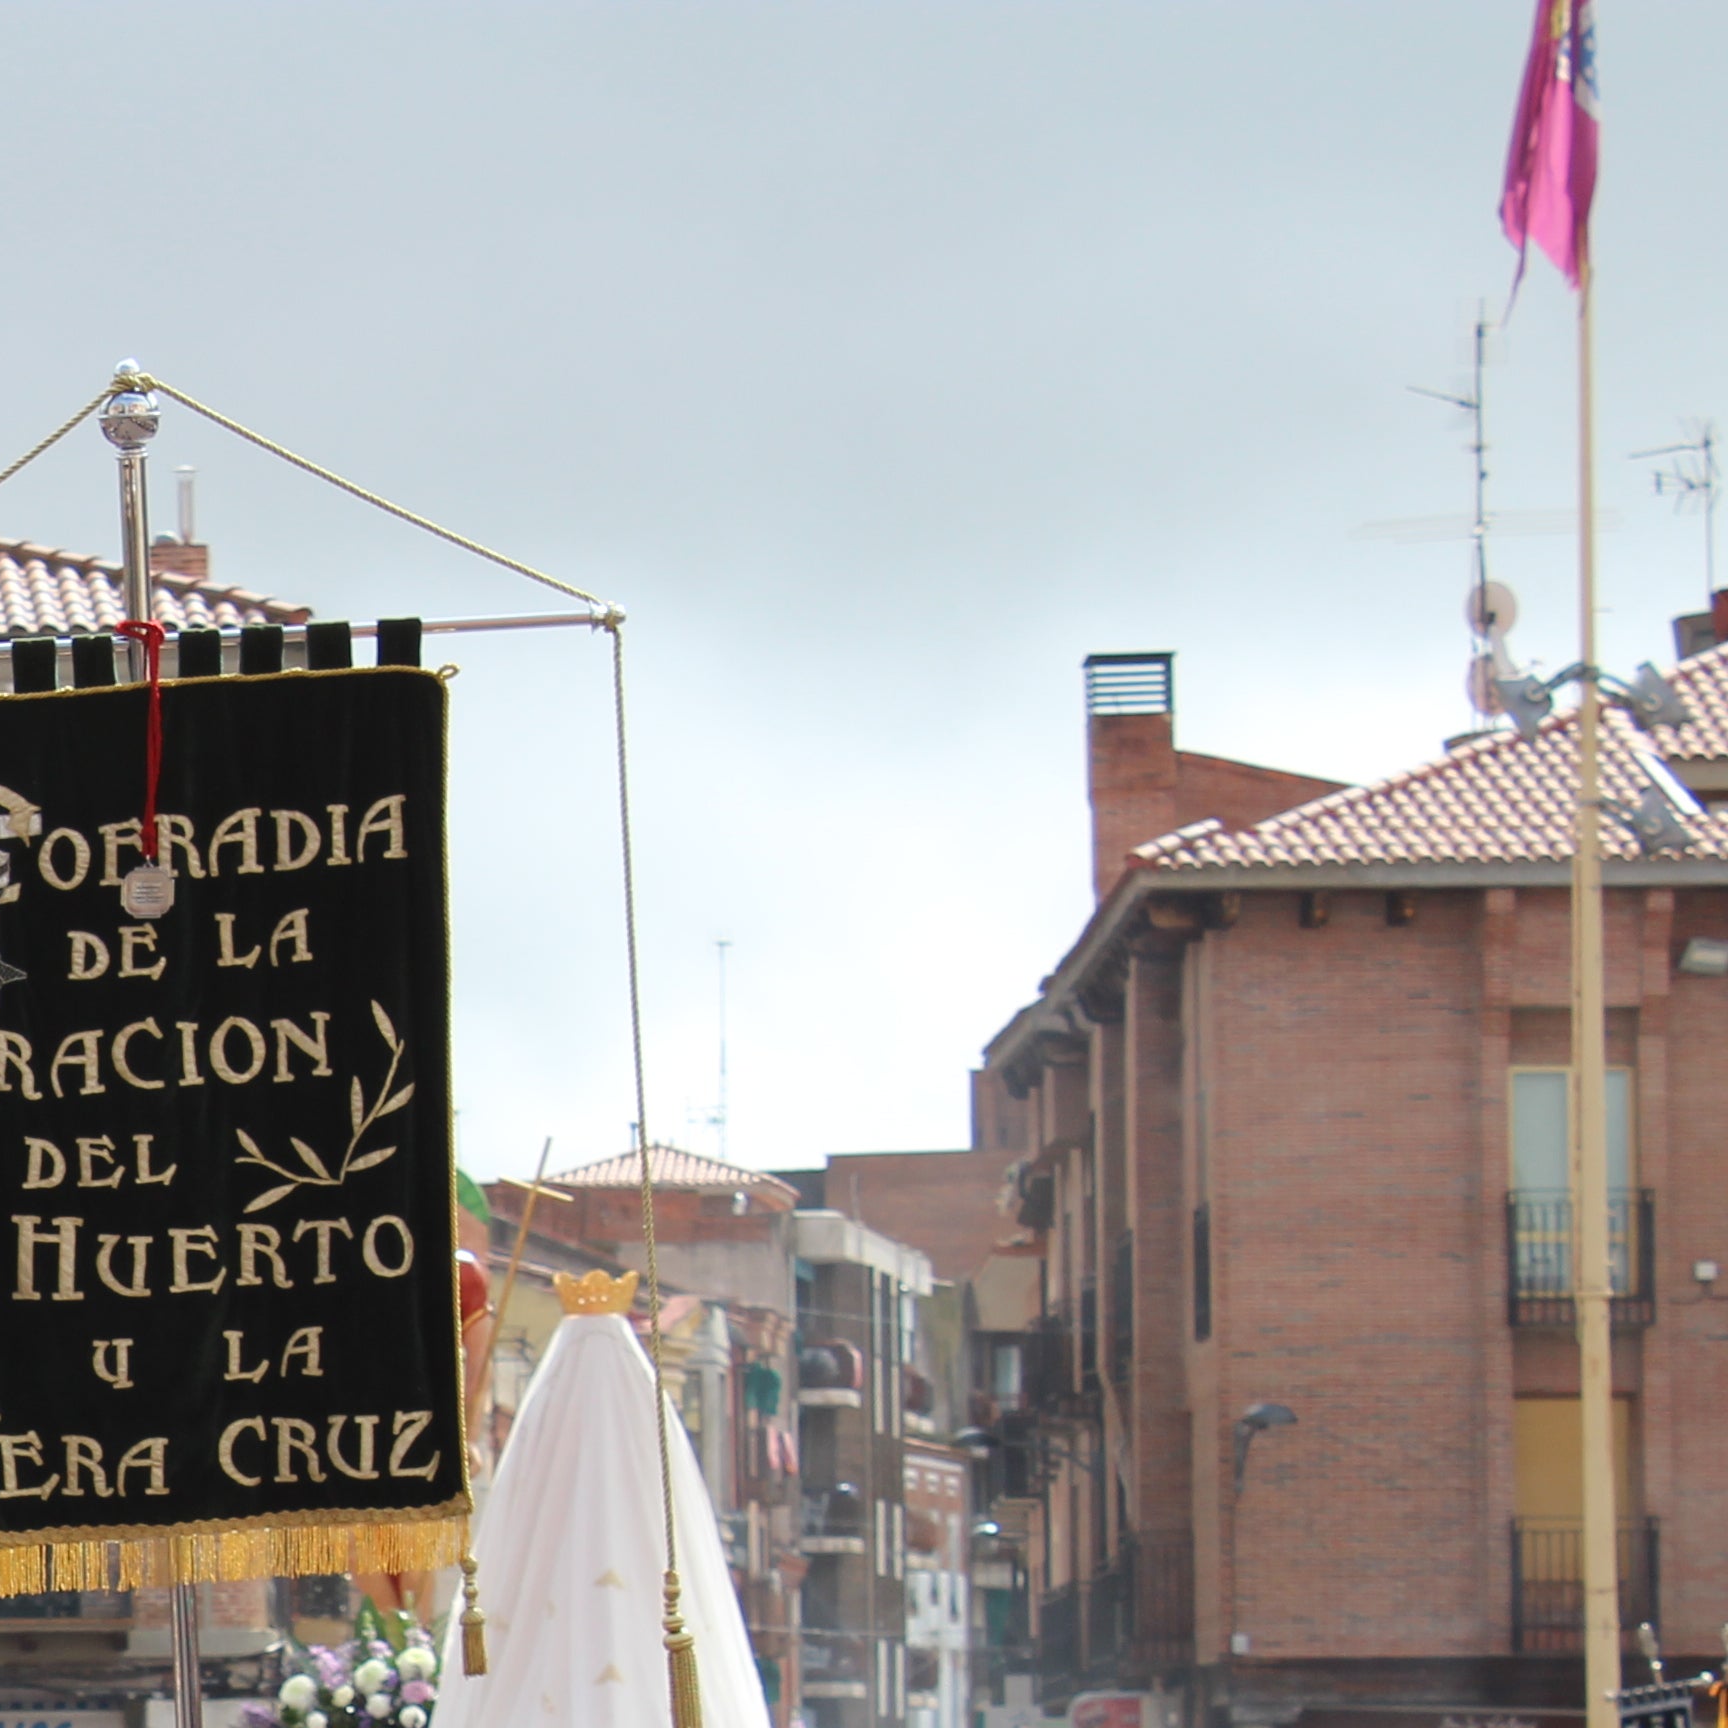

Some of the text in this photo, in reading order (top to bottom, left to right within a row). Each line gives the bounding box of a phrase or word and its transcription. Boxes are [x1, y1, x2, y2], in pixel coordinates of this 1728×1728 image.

[67, 907, 313, 981] DE LA
[21, 1133, 178, 1190] DEL
[10, 1214, 415, 1300] HUERTO
[222, 1325, 325, 1383] LA
[217, 1410, 441, 1487] CRUZ
